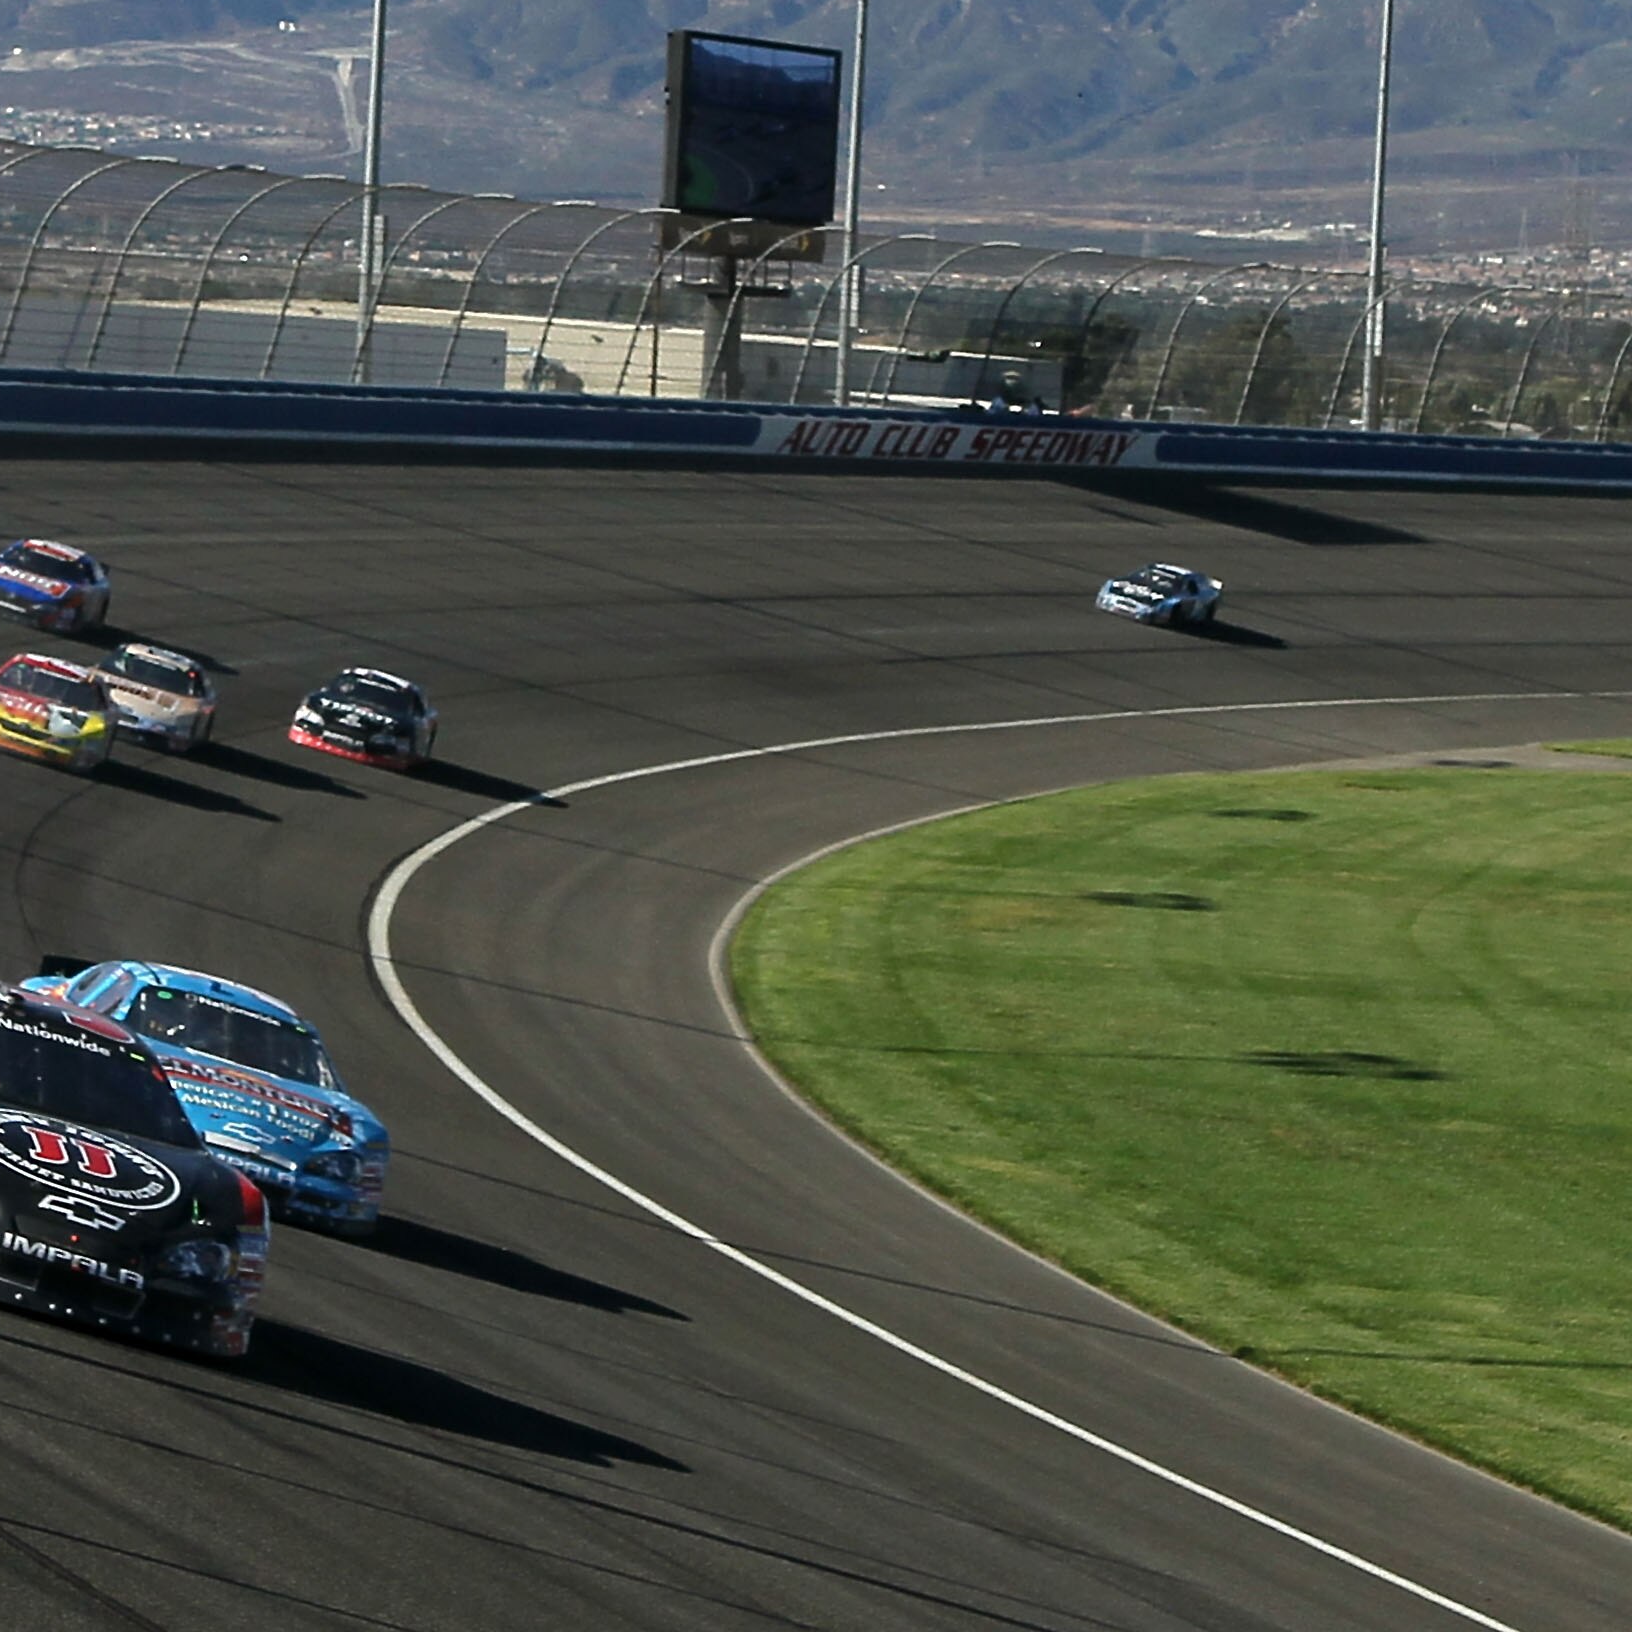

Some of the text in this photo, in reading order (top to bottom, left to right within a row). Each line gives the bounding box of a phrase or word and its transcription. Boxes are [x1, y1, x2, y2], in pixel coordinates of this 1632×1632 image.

[778, 420, 1138, 465] AUTO CLUB SPEEDWAY
[180, 1093, 262, 1119] Mexican
[2, 1231, 145, 1290] IMPALA
